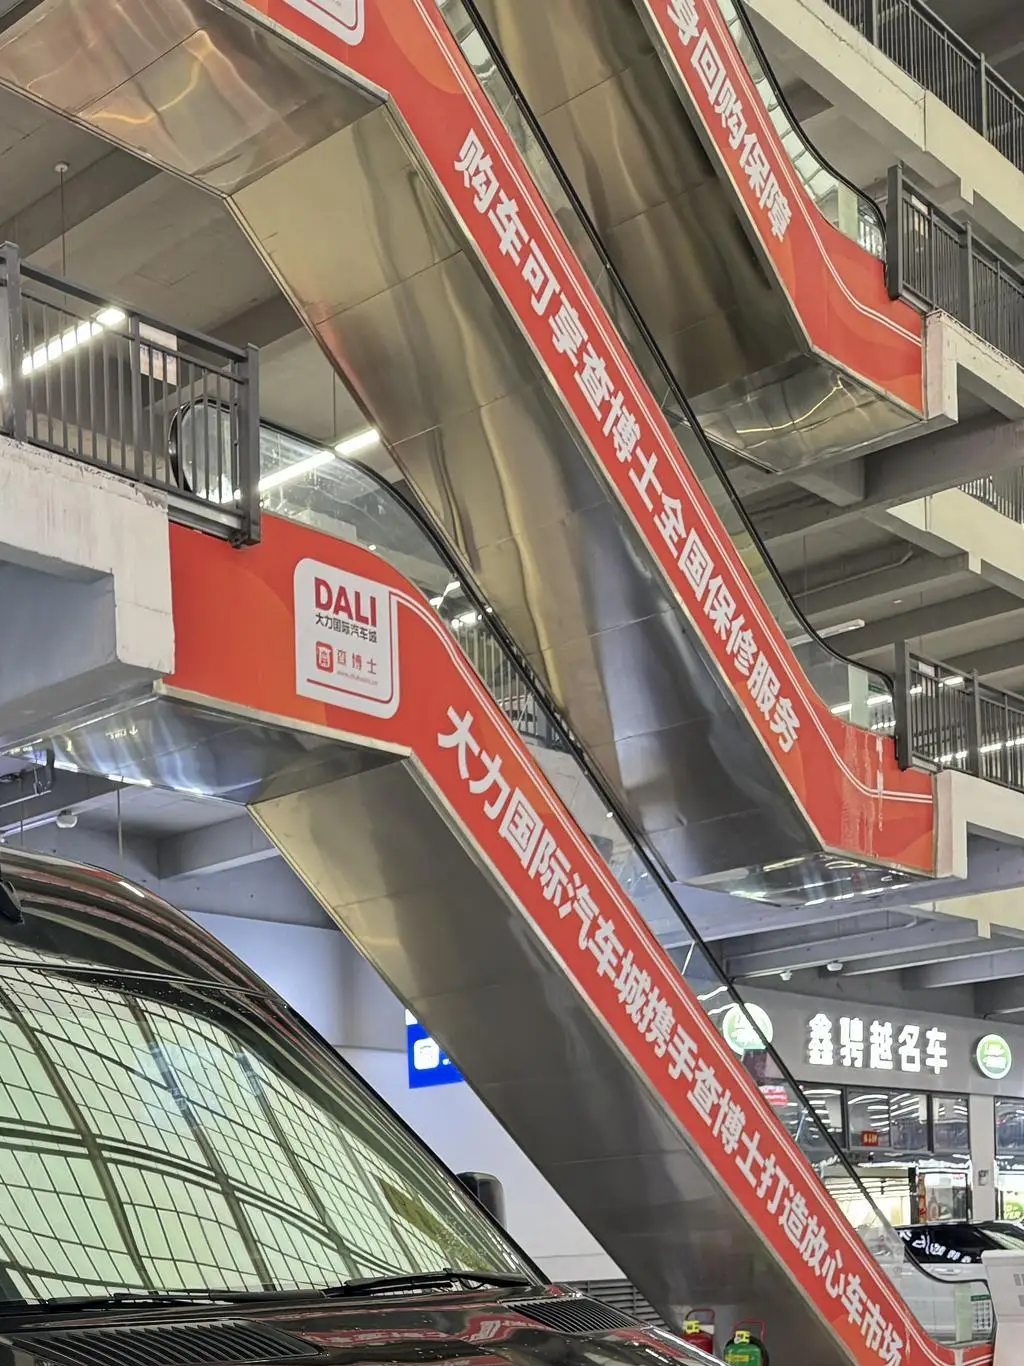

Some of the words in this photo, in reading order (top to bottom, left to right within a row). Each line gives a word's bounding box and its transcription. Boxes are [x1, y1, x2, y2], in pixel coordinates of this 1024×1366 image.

[454, 129, 799, 754] 购车可享查博士全国保修服务
[314, 576, 377, 628] DALI
[315, 612, 378, 643] 大力国际汽车城
